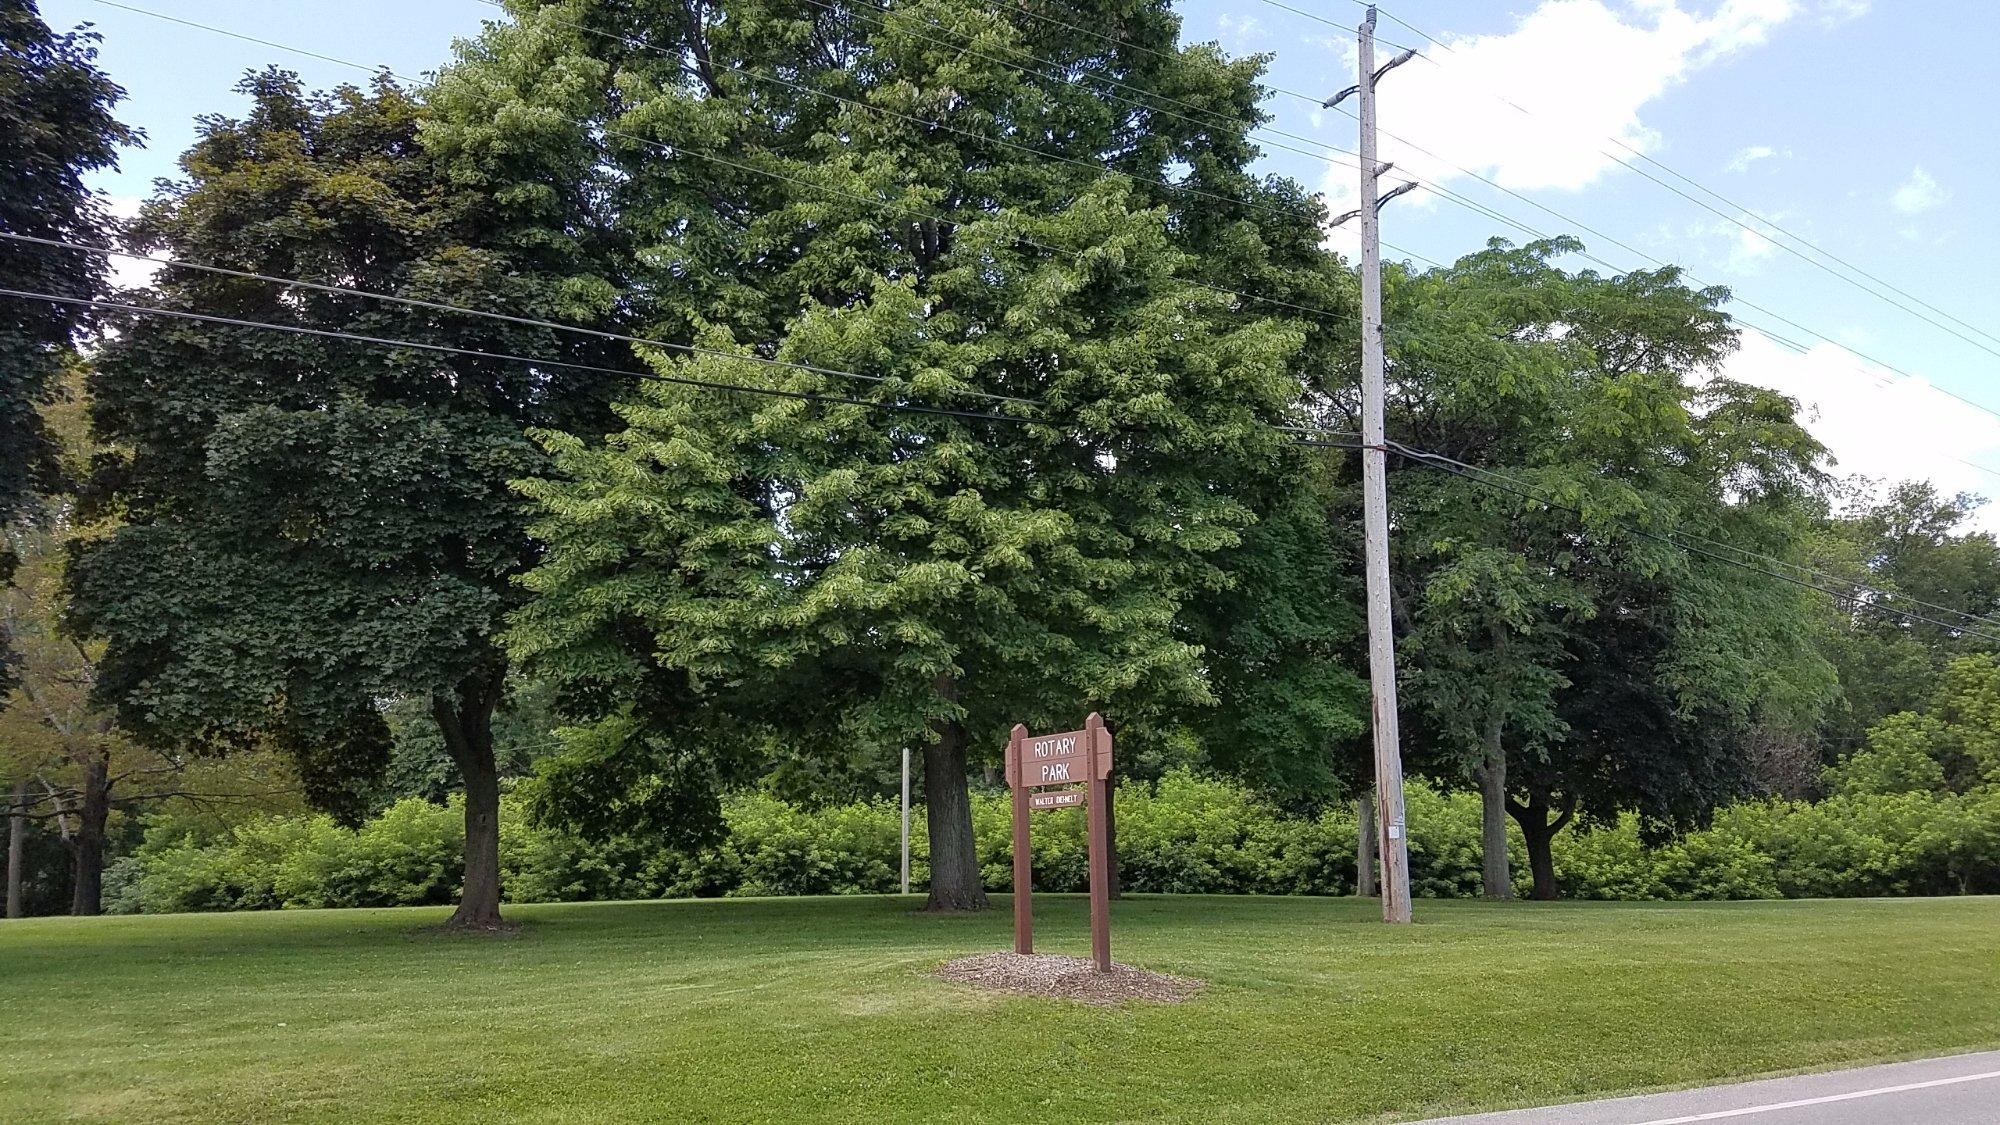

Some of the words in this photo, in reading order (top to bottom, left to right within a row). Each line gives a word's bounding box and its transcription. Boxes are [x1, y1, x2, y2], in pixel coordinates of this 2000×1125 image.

[1034, 736, 1076, 758] ROTARY
[1041, 763, 1070, 782] PARK
[1035, 796, 1054, 806] WALTER
